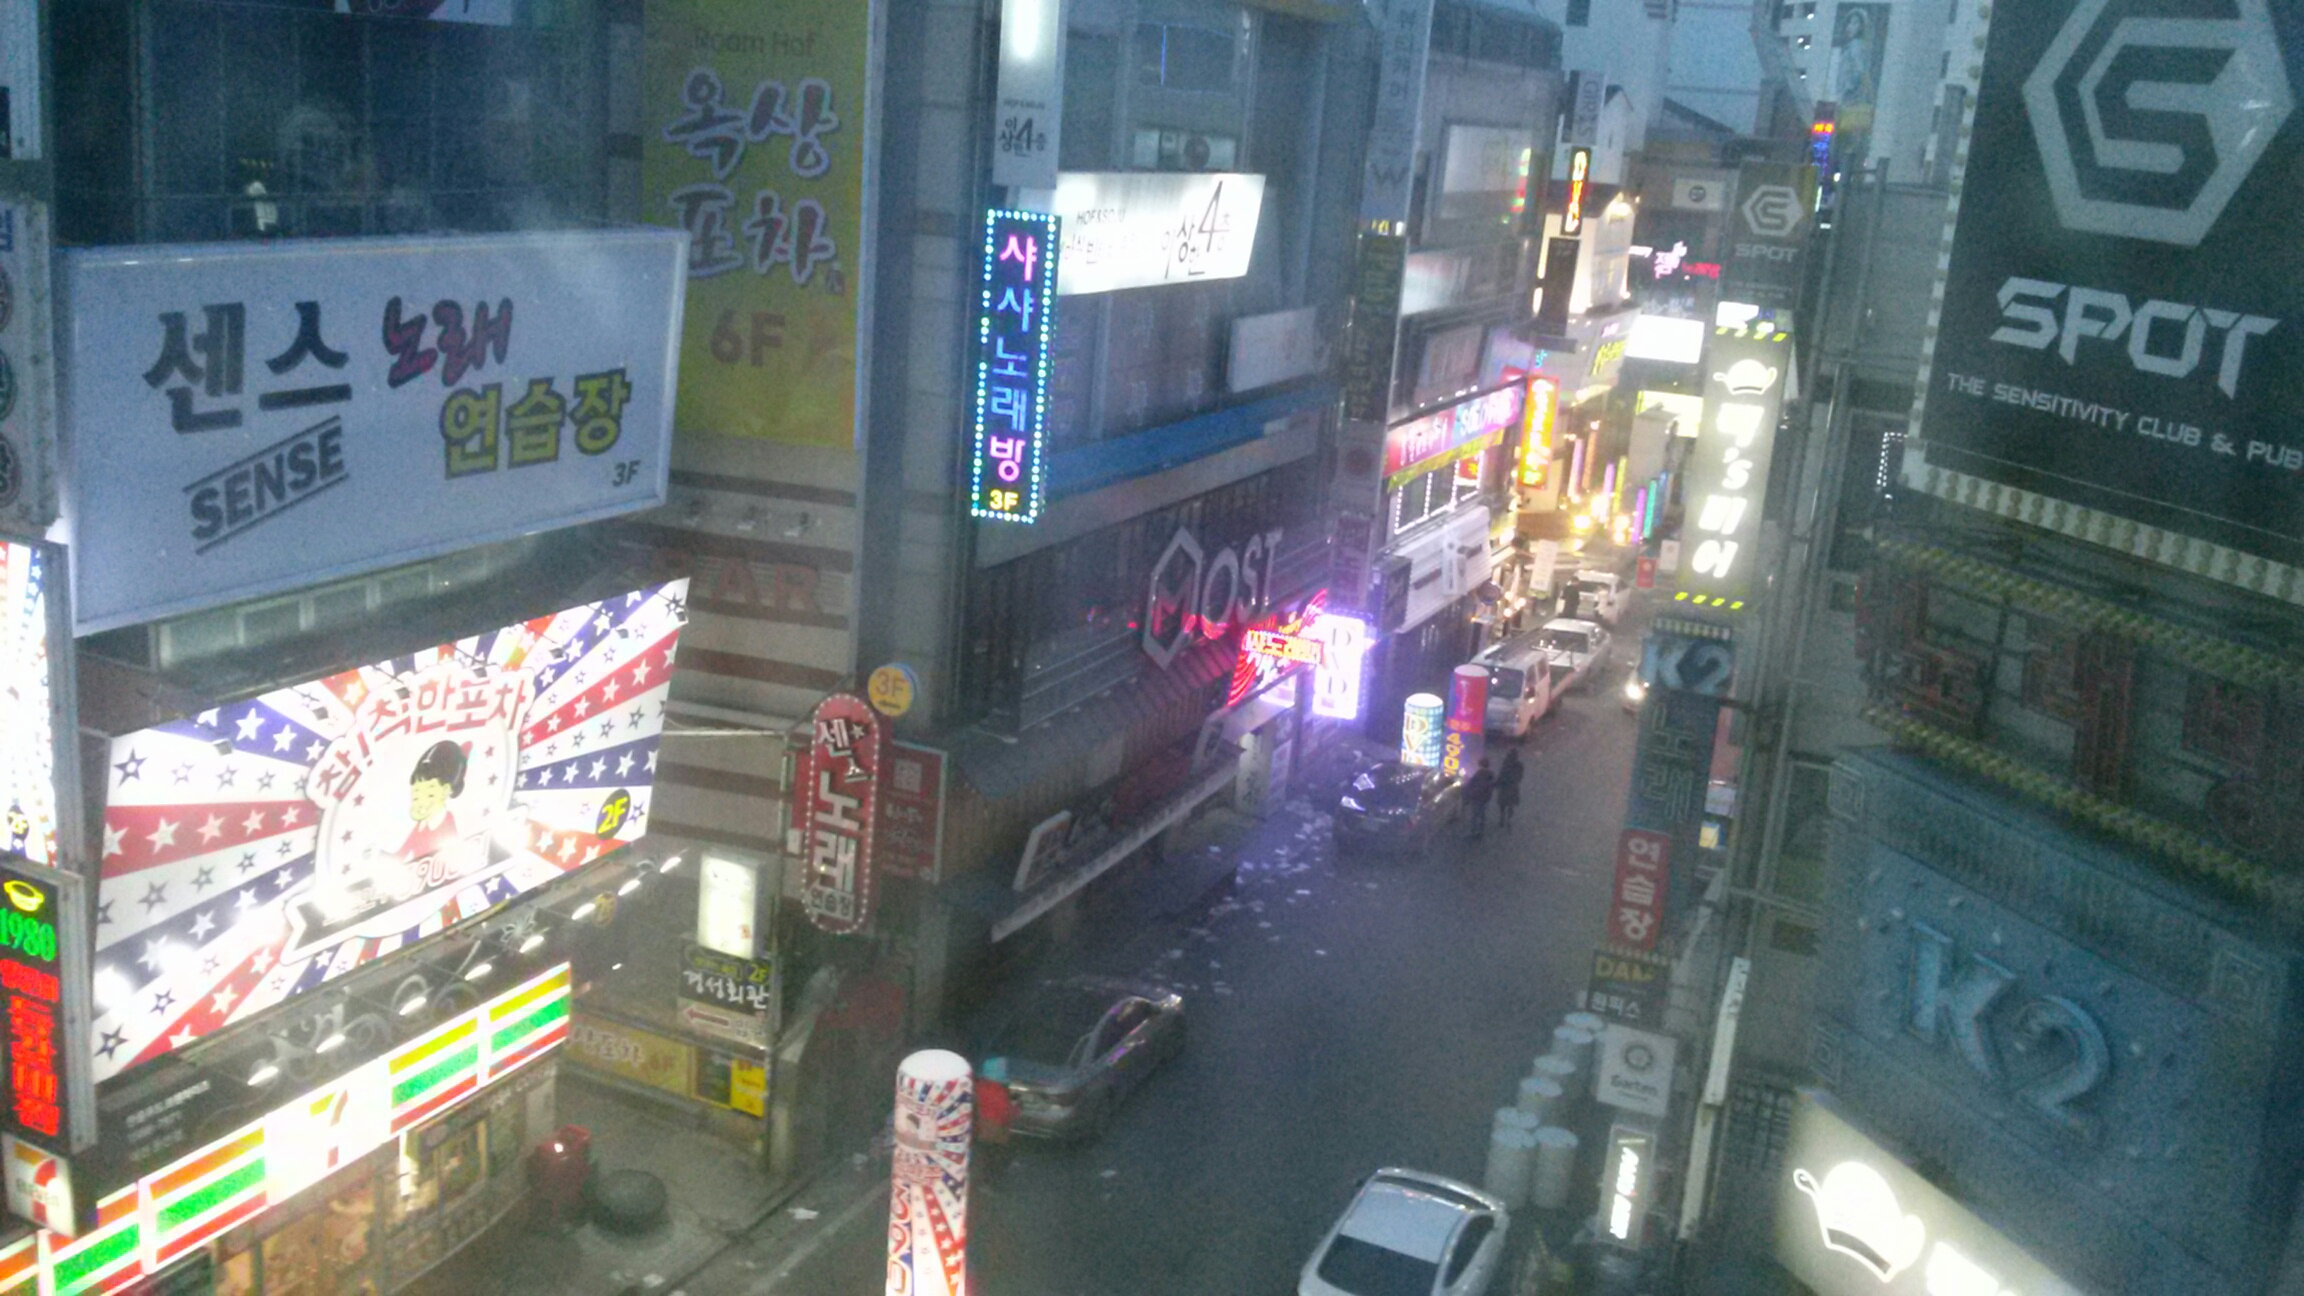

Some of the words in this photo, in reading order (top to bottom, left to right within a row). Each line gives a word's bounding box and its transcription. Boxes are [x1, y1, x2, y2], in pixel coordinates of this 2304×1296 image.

[662, 65, 840, 181] 옥상
[668, 183, 837, 285] 포차
[1734, 242, 1799, 263] SPOT
[142, 300, 352, 435] 센스
[381, 294, 515, 388] 노래
[710, 309, 786, 366] 6F
[1989, 276, 2282, 400] SPOT
[440, 367, 633, 479] 연습장
[1947, 372, 1985, 397] THE
[1993, 382, 2130, 433] SENSITIVITY
[2137, 416, 2202, 448] CLUB
[2210, 433, 2236, 457] &
[2246, 440, 2304, 472] PUB
[188, 424, 346, 539] SENSE
[612, 459, 641, 488] 3F
[989, 489, 1019, 512] 3F
[875, 669, 905, 695] 3F
[1636, 640, 1735, 698] K2
[368, 674, 525, 742] 착한포차
[817, 717, 874, 783] 센스
[598, 791, 631, 836] 2F
[812, 769, 860, 893] 노래
[1618, 836, 1661, 942] 연습장
[0, 906, 57, 962] 1980
[683, 968, 770, 1010] 경성회관
[1909, 918, 2113, 1124] K2
